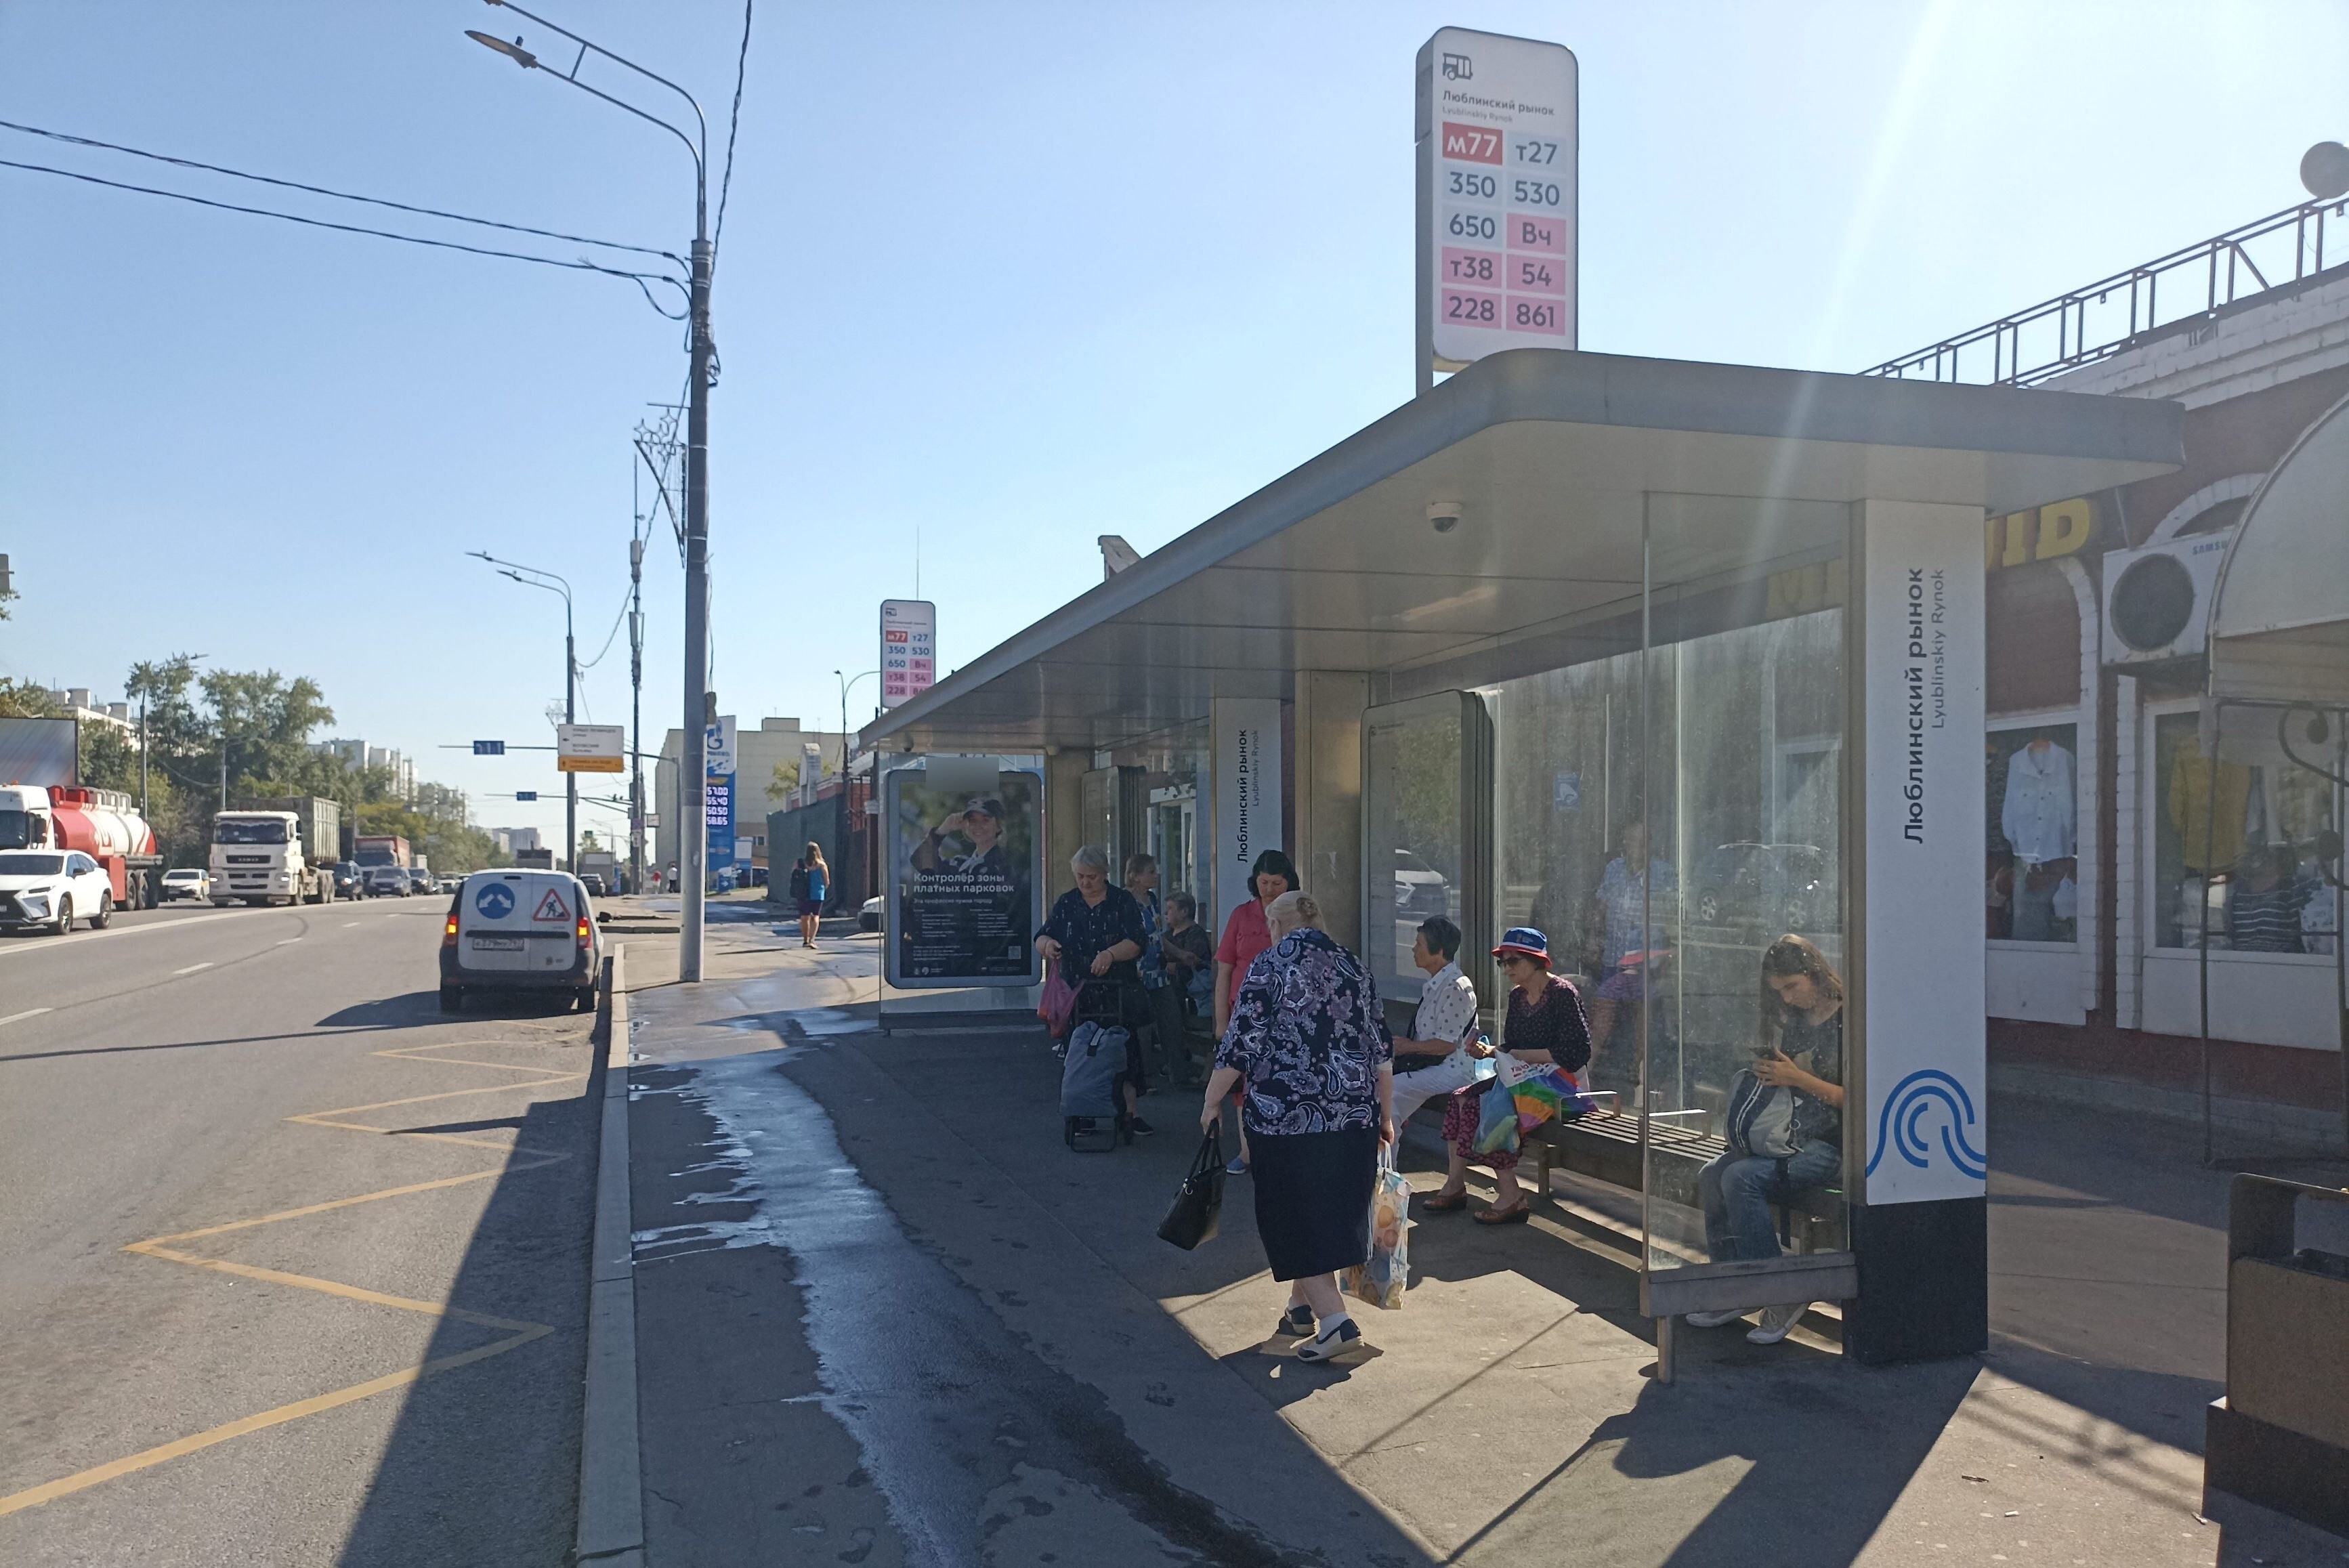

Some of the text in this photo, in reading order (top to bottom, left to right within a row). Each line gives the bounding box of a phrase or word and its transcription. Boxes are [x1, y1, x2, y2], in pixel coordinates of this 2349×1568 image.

[1442, 90, 1556, 116] Люблинский рынок
[1447, 130, 1558, 166] м77 т27
[1448, 171, 1561, 207] 350 530
[1448, 213, 1496, 240] 650
[1450, 257, 1552, 287] т38 54
[1448, 296, 1555, 329] 228 861
[2192, 541, 2228, 555] SAMSU
[888, 646, 930, 656] 350 530
[1931, 568, 1947, 729] Lyublinskiy Rynok
[888, 660, 906, 668] 650
[1904, 568, 1927, 845] Люблинский рынок
[1252, 730, 1260, 757] Rynok
[1237, 729, 1249, 863] Люблинский рынок
[913, 872, 1004, 884] Контролёр зоны
[913, 885, 1015, 894] платных парковок
